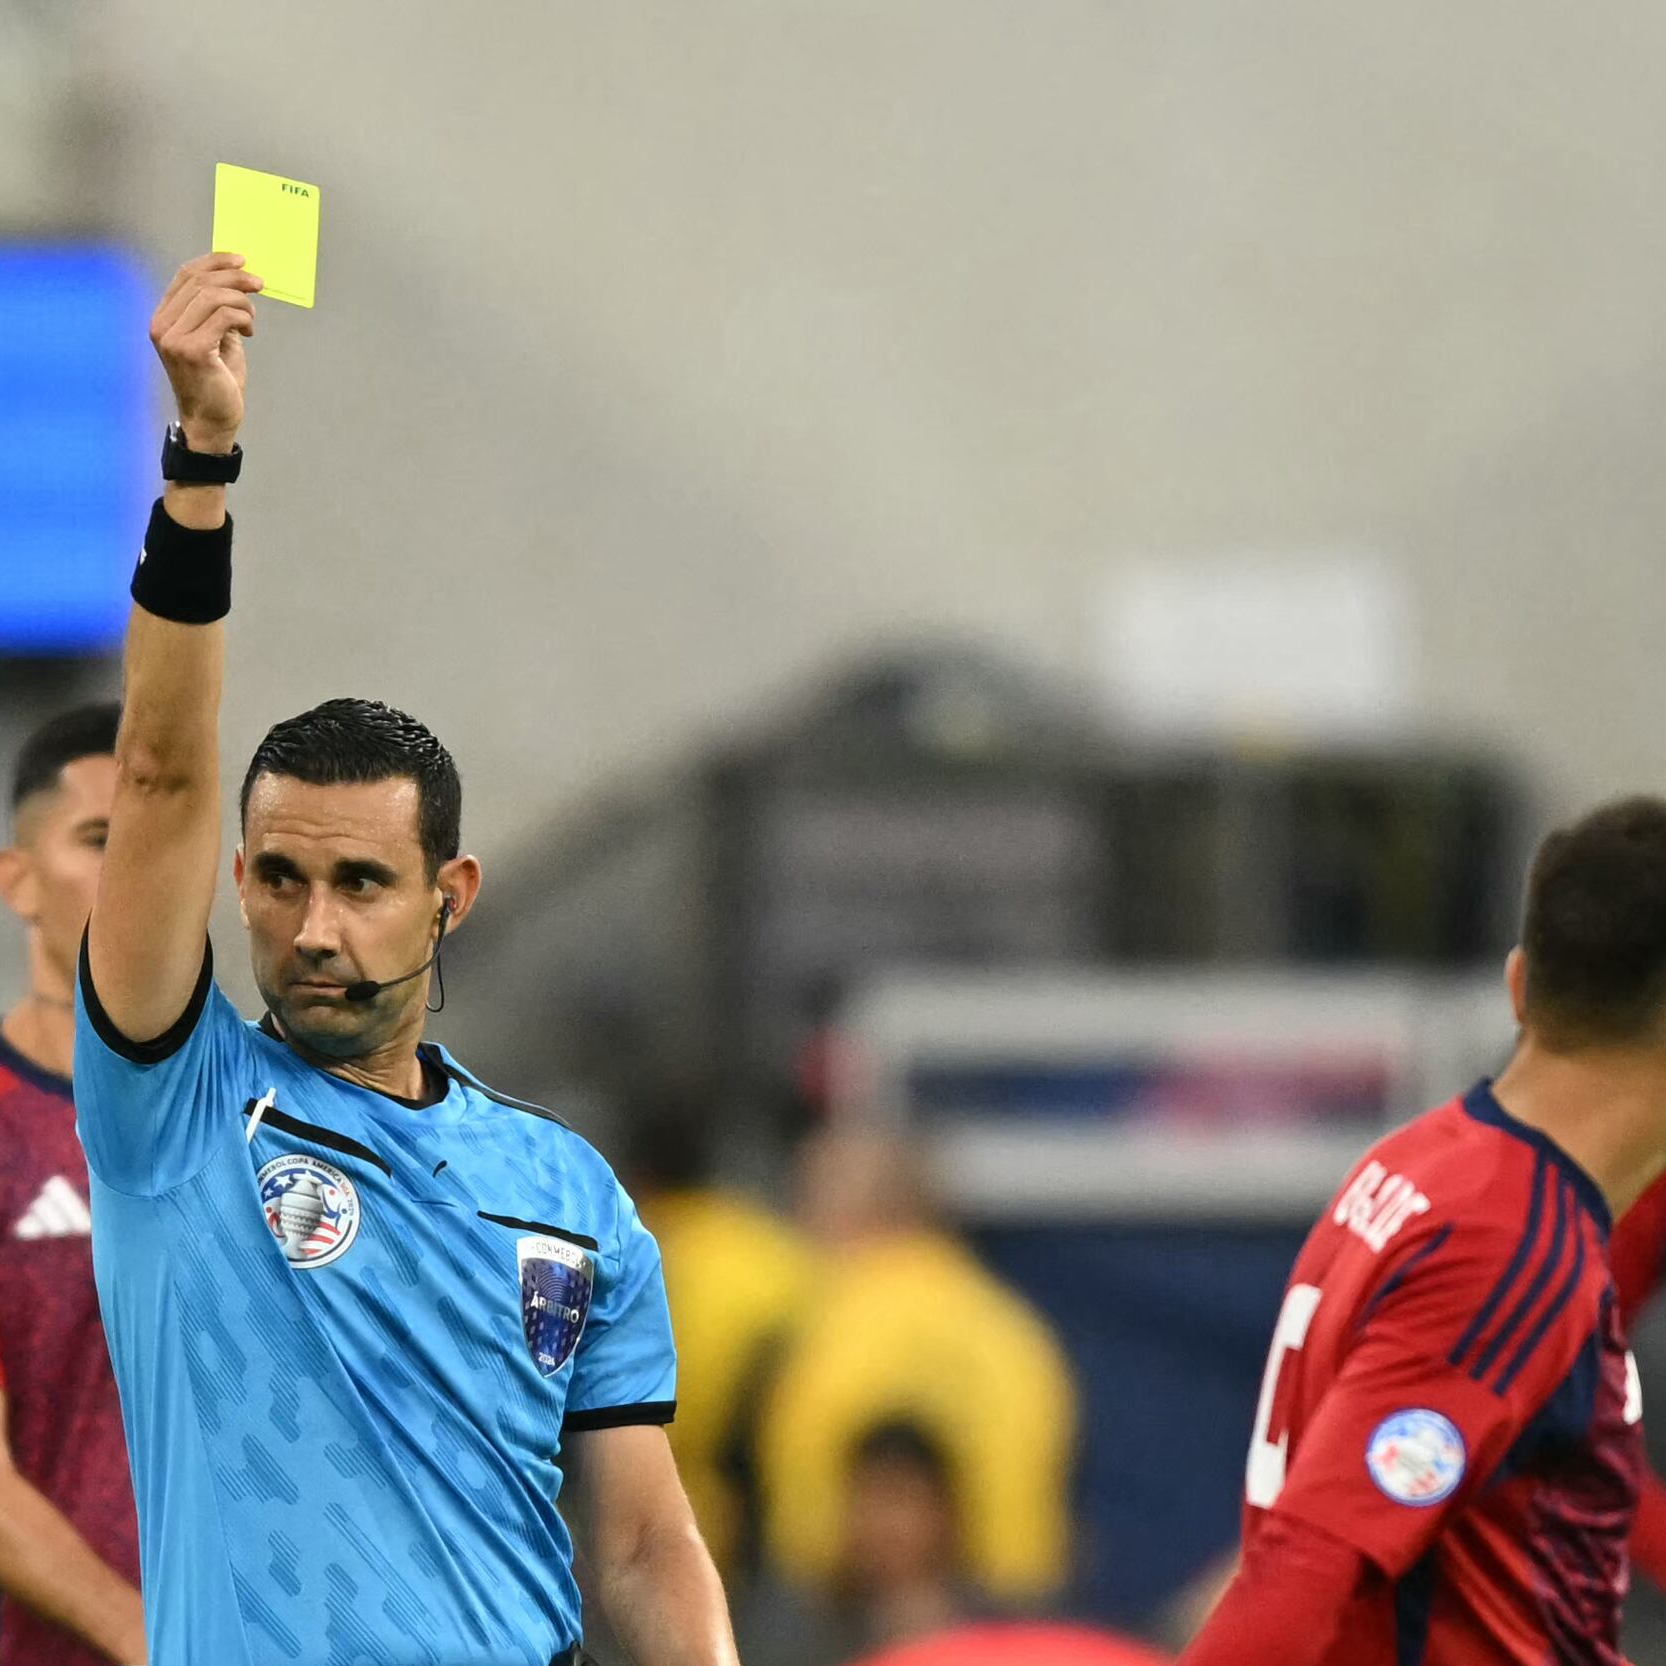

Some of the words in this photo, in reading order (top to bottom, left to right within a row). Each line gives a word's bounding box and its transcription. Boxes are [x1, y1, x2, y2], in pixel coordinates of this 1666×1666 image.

[281, 183, 310, 198] FIFA
[530, 1291, 580, 1324] ÁRBITRO
[538, 1351, 555, 1366] 2024
